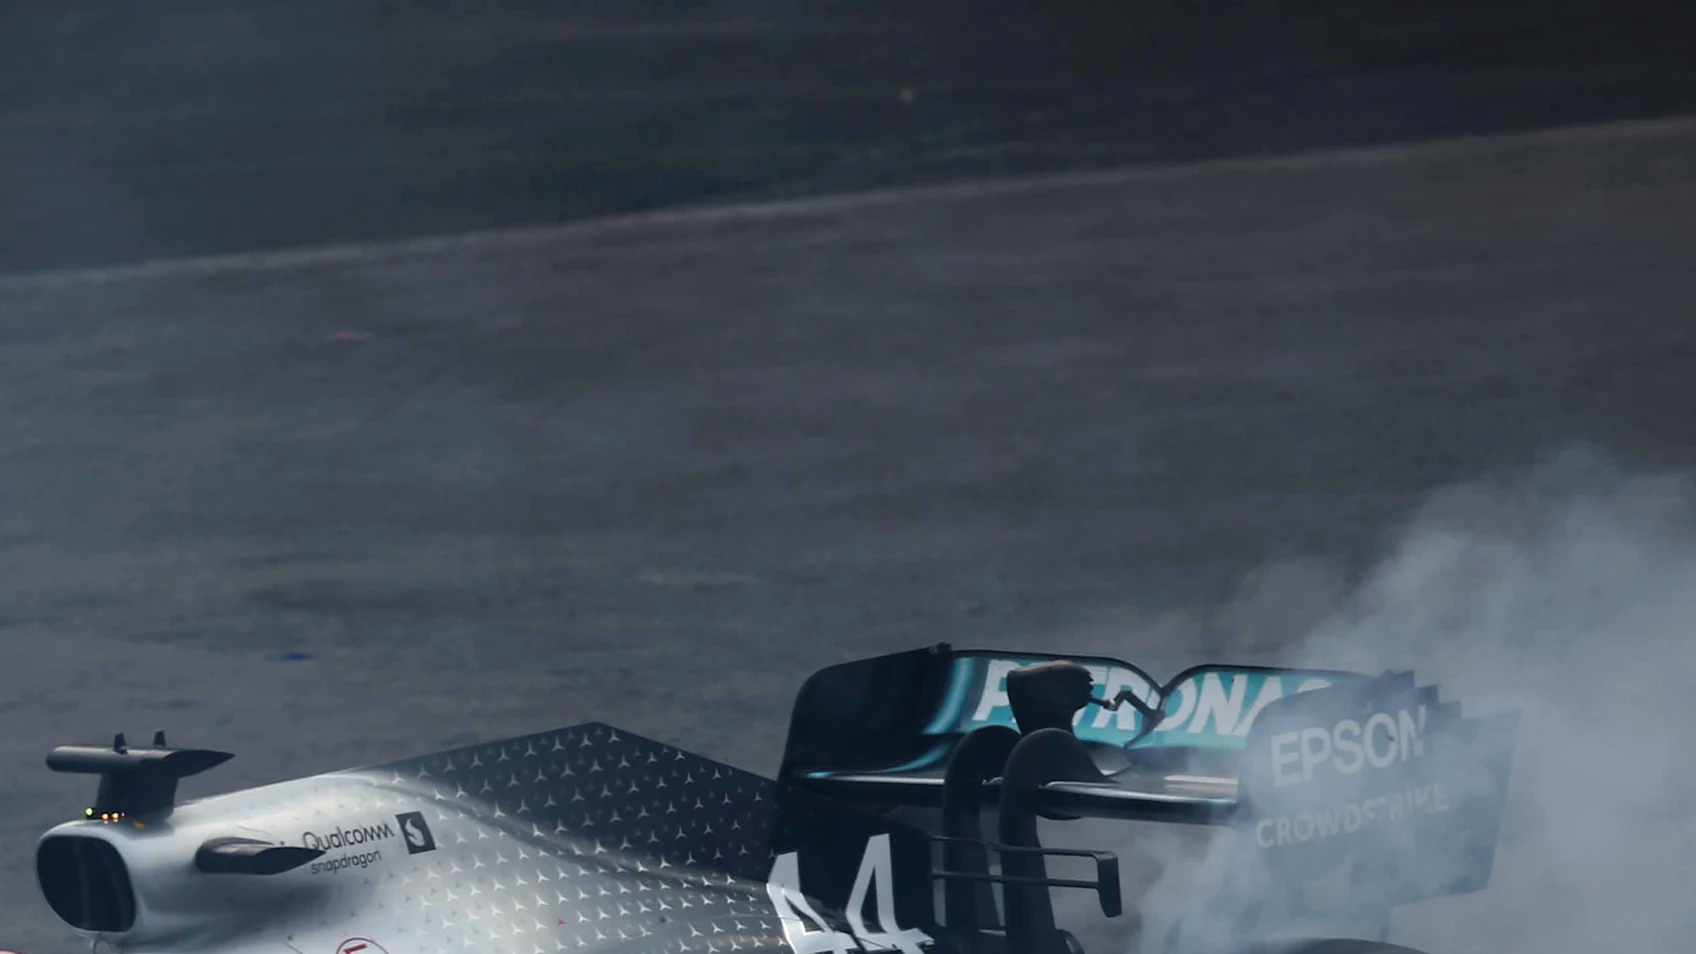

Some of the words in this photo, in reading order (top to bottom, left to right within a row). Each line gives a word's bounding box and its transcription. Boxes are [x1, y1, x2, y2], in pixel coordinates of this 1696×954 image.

[1271, 705, 1427, 788] EPSON
[1256, 780, 1450, 848] CROWDSTRIKE
[302, 825, 395, 851] Qualcomm
[311, 849, 382, 874] snapdragon
